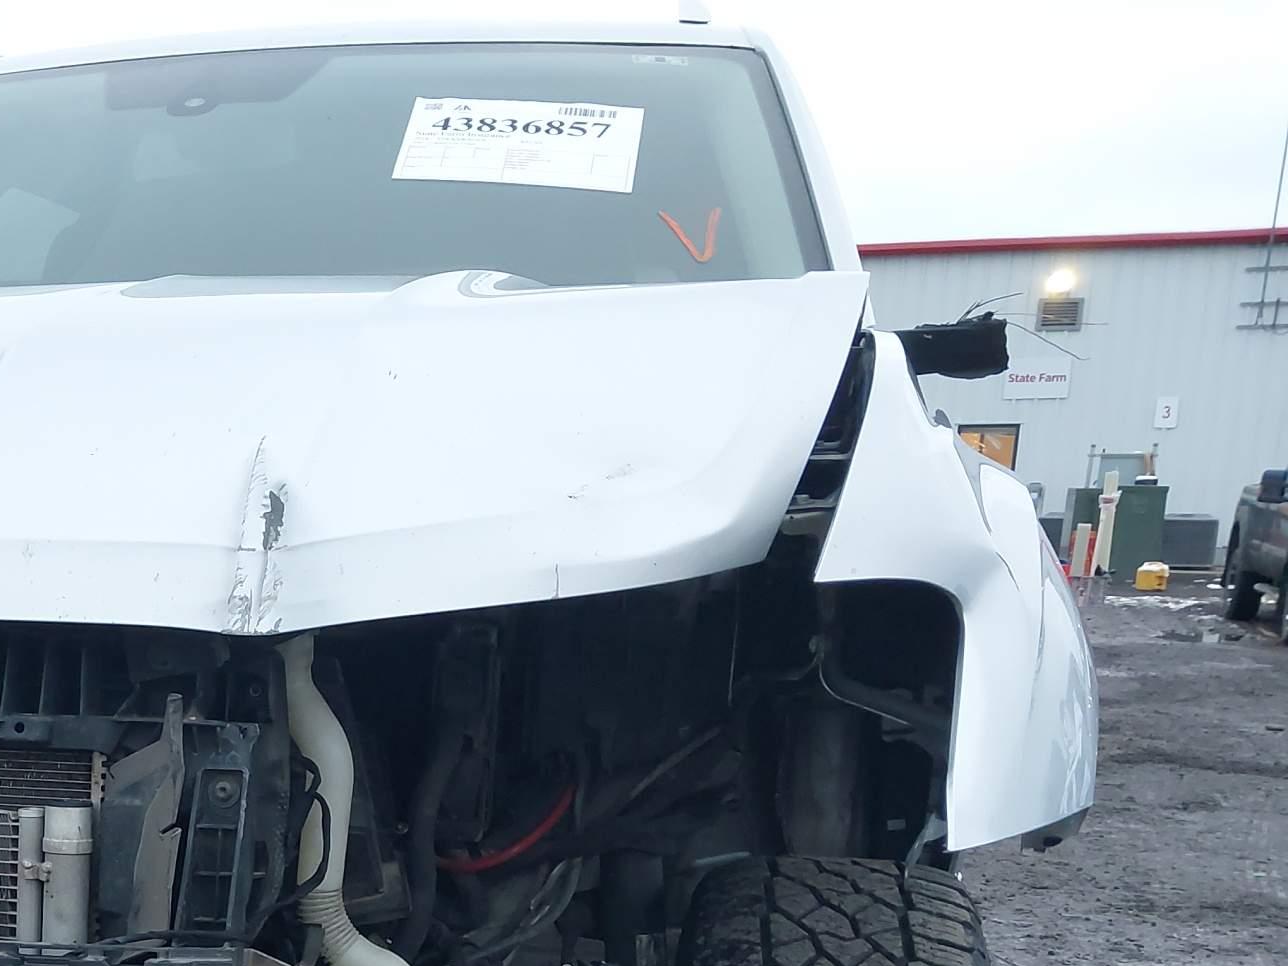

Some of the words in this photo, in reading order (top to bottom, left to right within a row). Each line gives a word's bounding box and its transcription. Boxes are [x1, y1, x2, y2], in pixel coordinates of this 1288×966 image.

[431, 117, 612, 138] 43836857
[1008, 373, 1036, 383] State
[1039, 373, 1067, 383] Farm
[1162, 406, 1171, 419] 3
